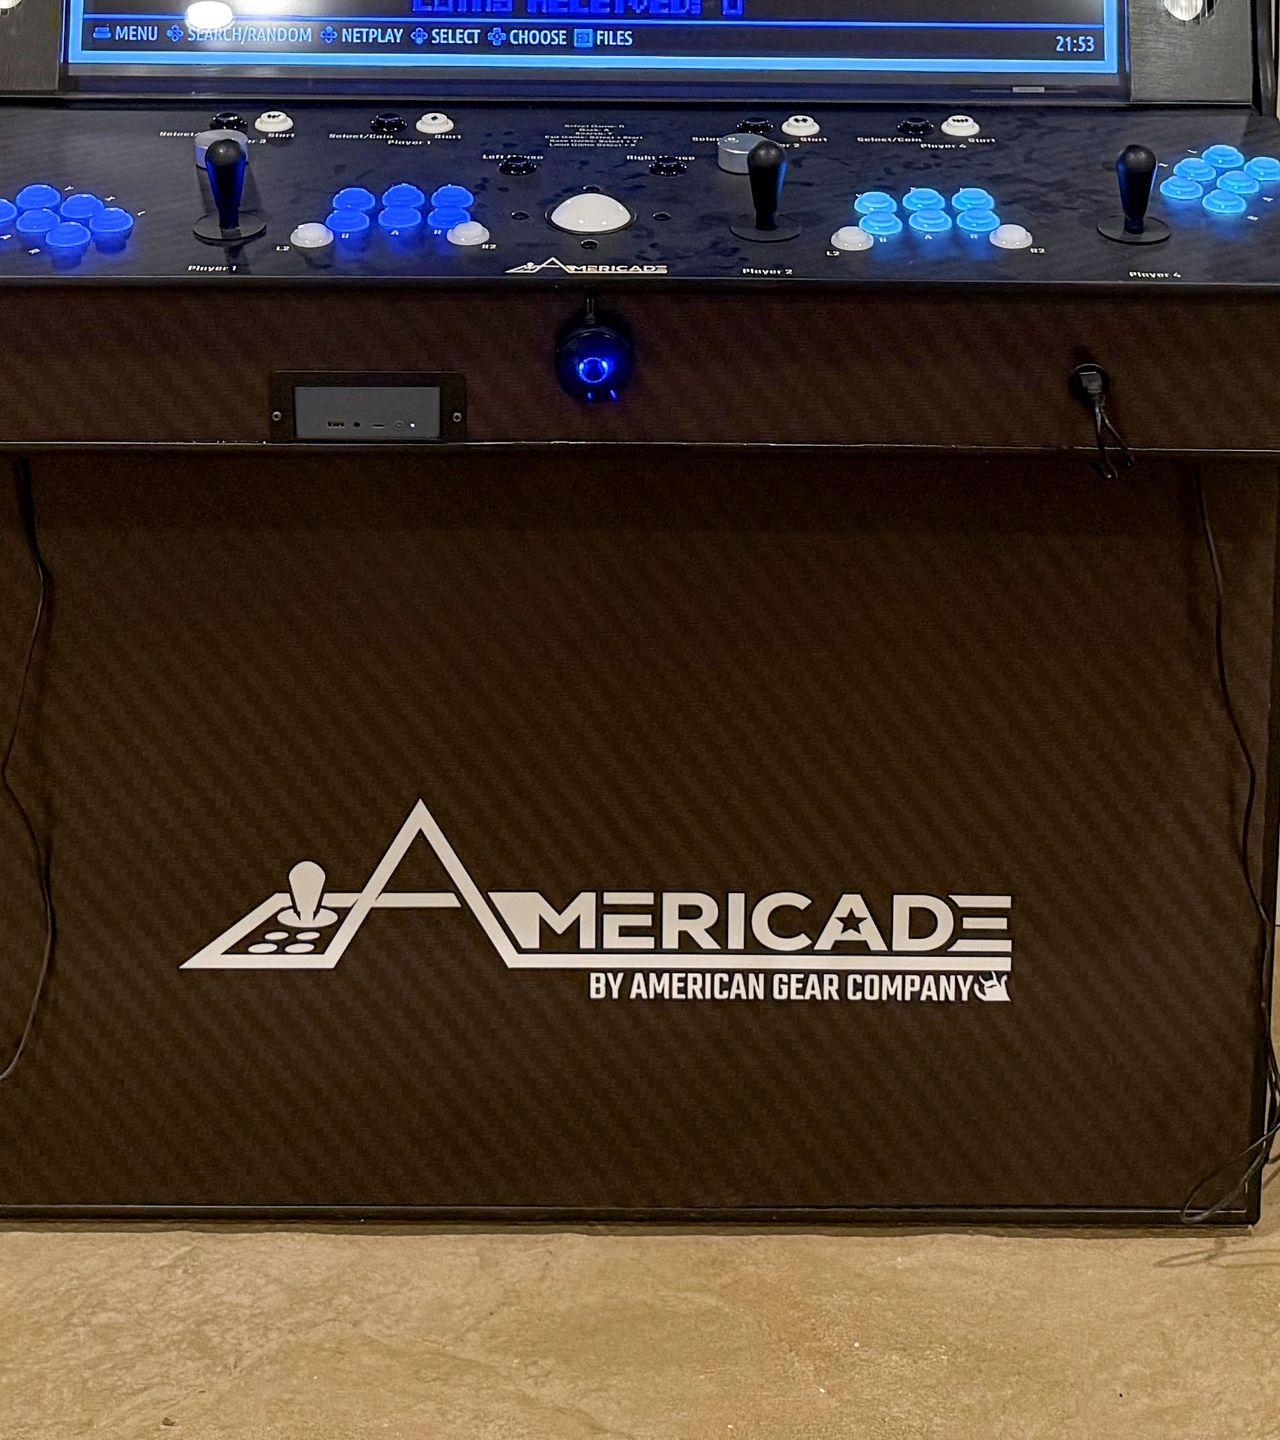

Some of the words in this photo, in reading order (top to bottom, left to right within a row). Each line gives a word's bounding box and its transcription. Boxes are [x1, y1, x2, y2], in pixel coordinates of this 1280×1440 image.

[115, 25, 158, 41] MENU
[188, 25, 313, 45] SEARCH/RANDOM
[341, 27, 405, 44] NETPLAY
[431, 29, 481, 45] SELECT
[509, 29, 568, 45] CHOOSE
[596, 30, 633, 46] FILES
[1055, 35, 1096, 53] 21:53
[524, 256, 668, 273] AMERICADE
[742, 267, 783, 275] Player
[1129, 271, 1170, 279] Player
[320, 798, 1012, 969] AMERICADE
[589, 972, 622, 1001] BY
[629, 972, 767, 1002] AMERICAN
[771, 973, 840, 1002] GEAR
[846, 974, 975, 1003] COMPANY
